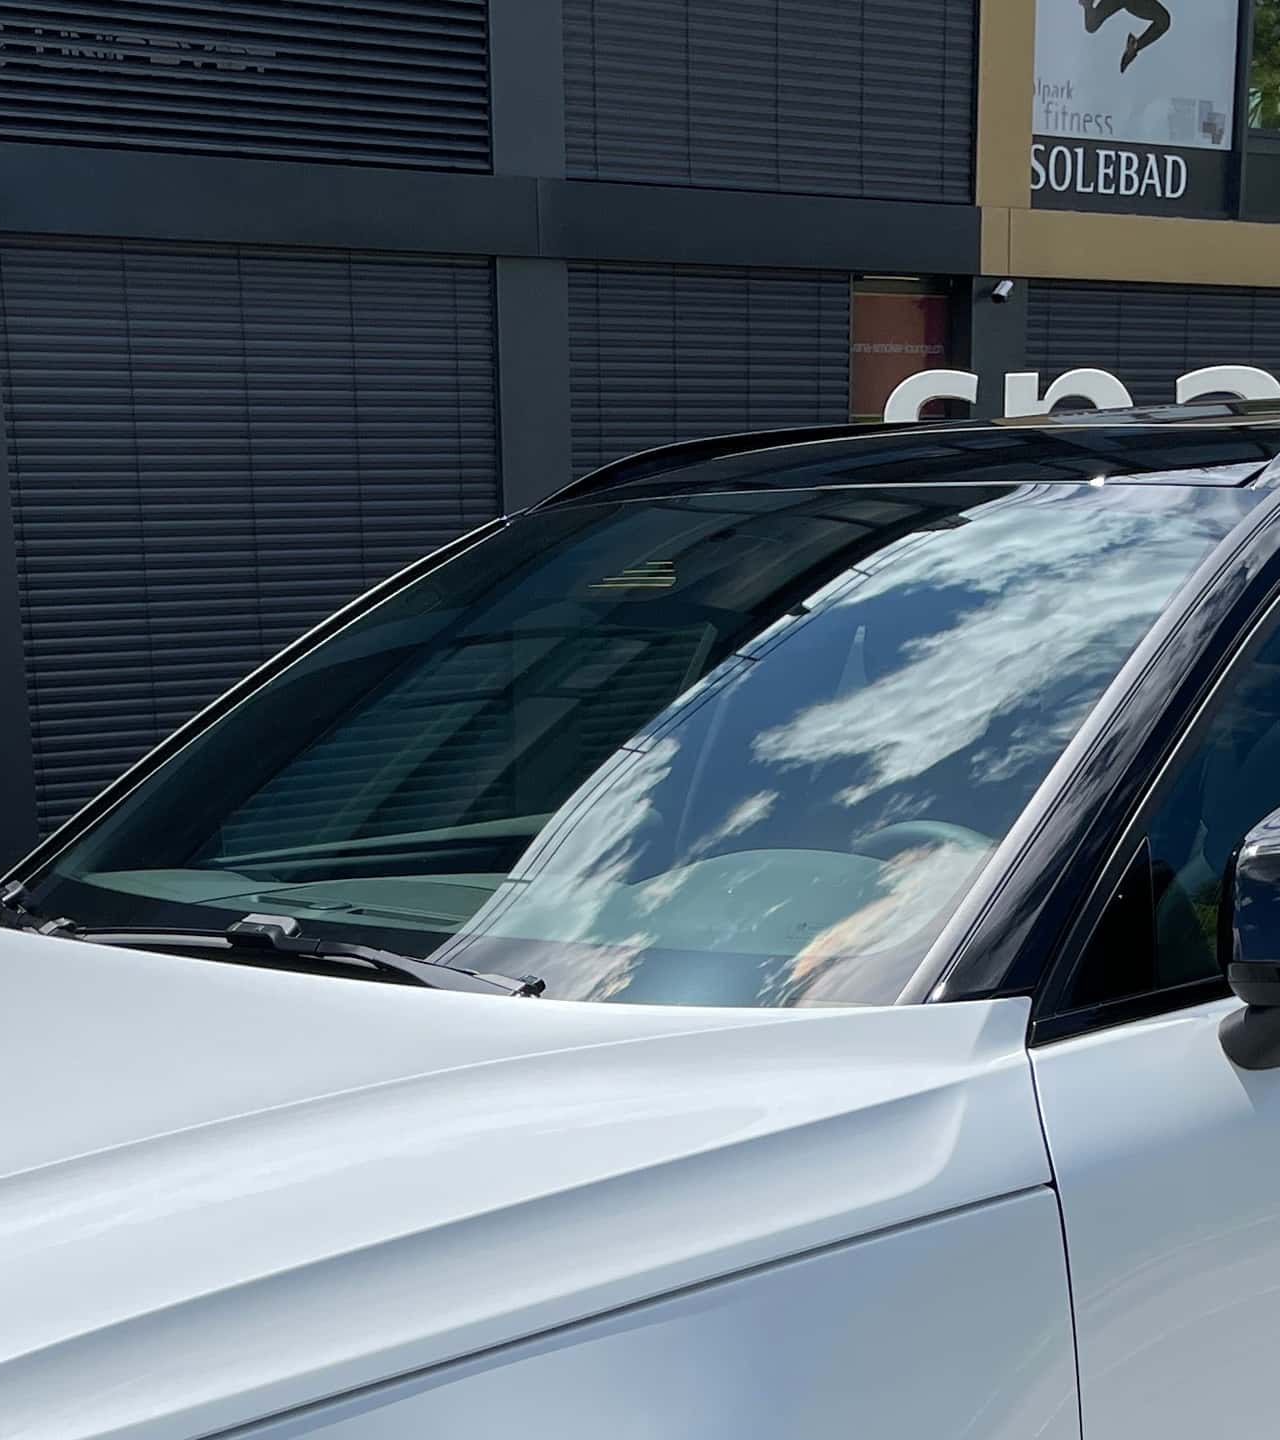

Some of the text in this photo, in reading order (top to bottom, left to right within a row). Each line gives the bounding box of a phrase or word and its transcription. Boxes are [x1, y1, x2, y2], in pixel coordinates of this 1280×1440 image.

[1032, 78, 1074, 105] lpark
[1044, 101, 1114, 136] fitness
[1030, 142, 1188, 199] SOLEBAD
